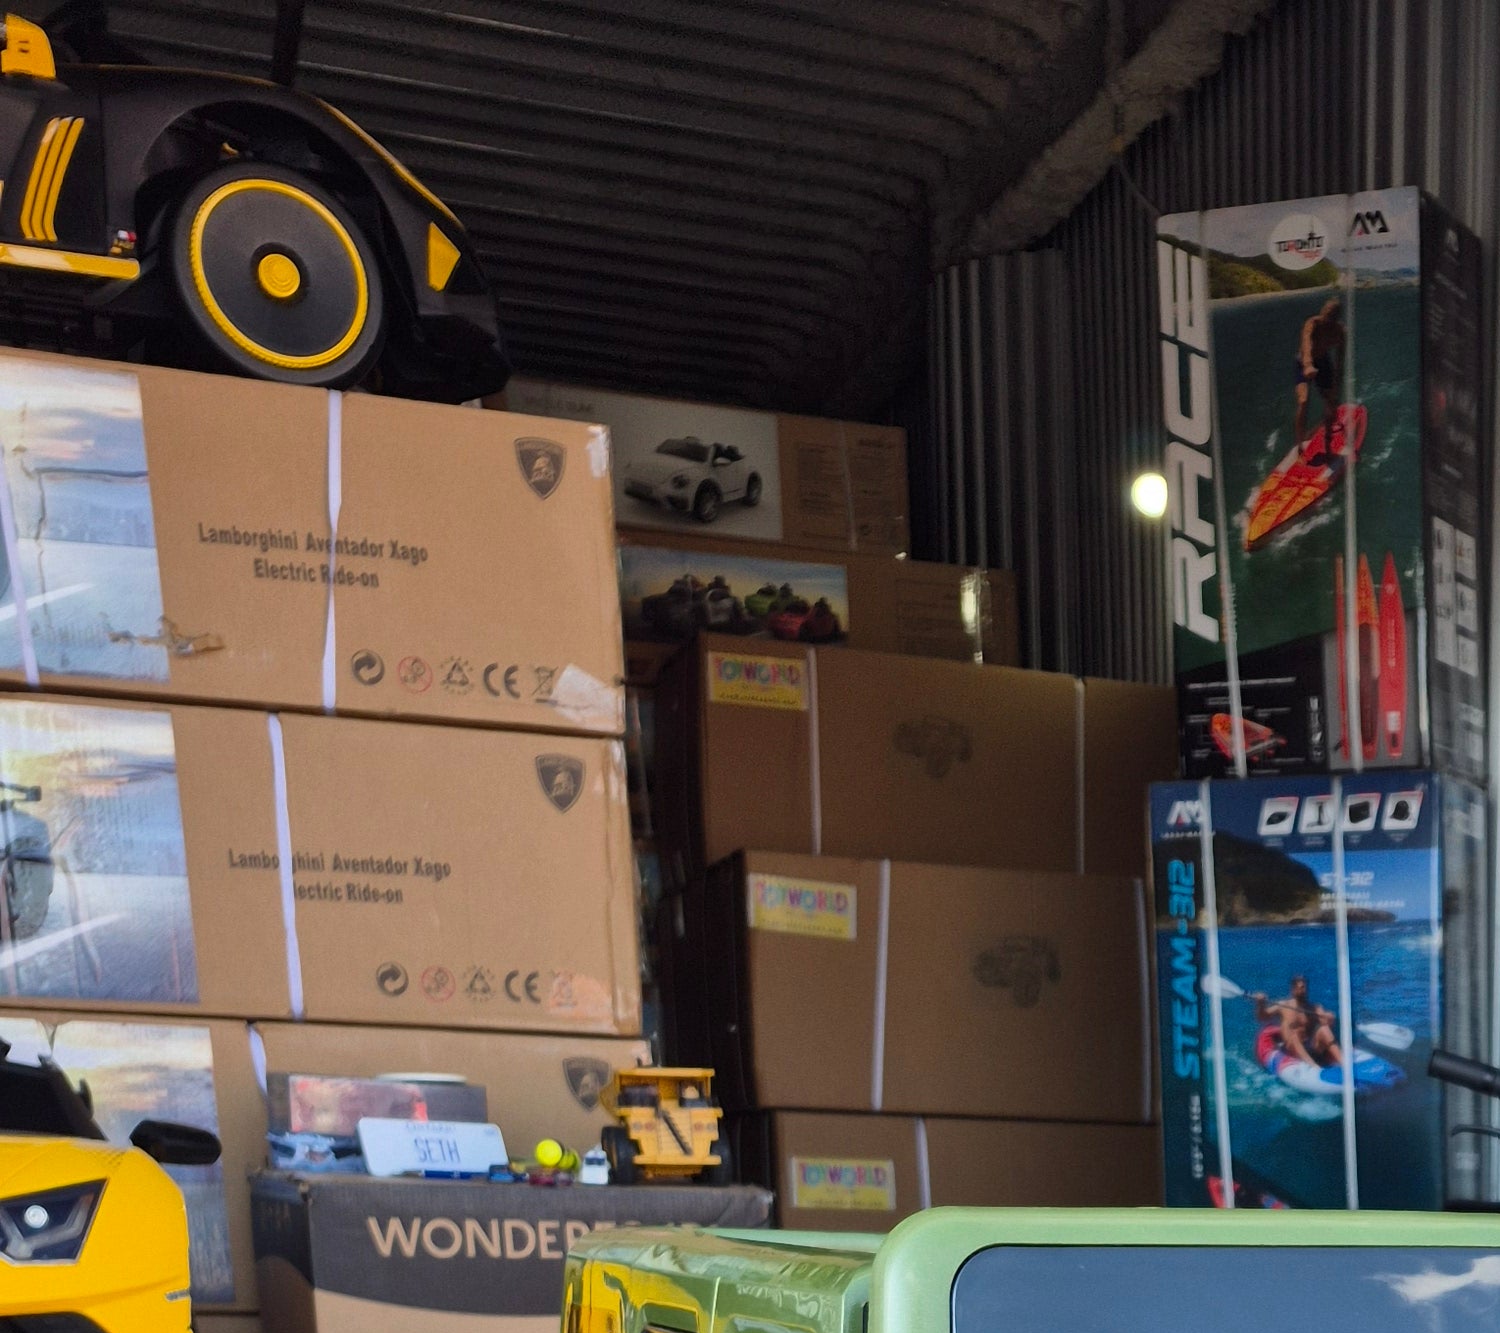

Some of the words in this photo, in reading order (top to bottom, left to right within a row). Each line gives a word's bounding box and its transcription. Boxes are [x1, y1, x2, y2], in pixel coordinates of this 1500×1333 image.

[1158, 240, 1219, 643] RACE
[198, 522, 298, 552] Lamborghini
[305, 532, 384, 558] Aventador
[388, 540, 429, 566] Xago
[253, 558, 316, 583] Electric
[319, 564, 380, 588] Ride-on
[228, 848, 325, 873] Lamboghini
[332, 853, 409, 876] Aventador
[412, 857, 452, 882] Xago
[293, 881, 343, 901] lectric
[345, 882, 404, 903] Ride-on
[1167, 858, 1201, 1082] STEAM-312
